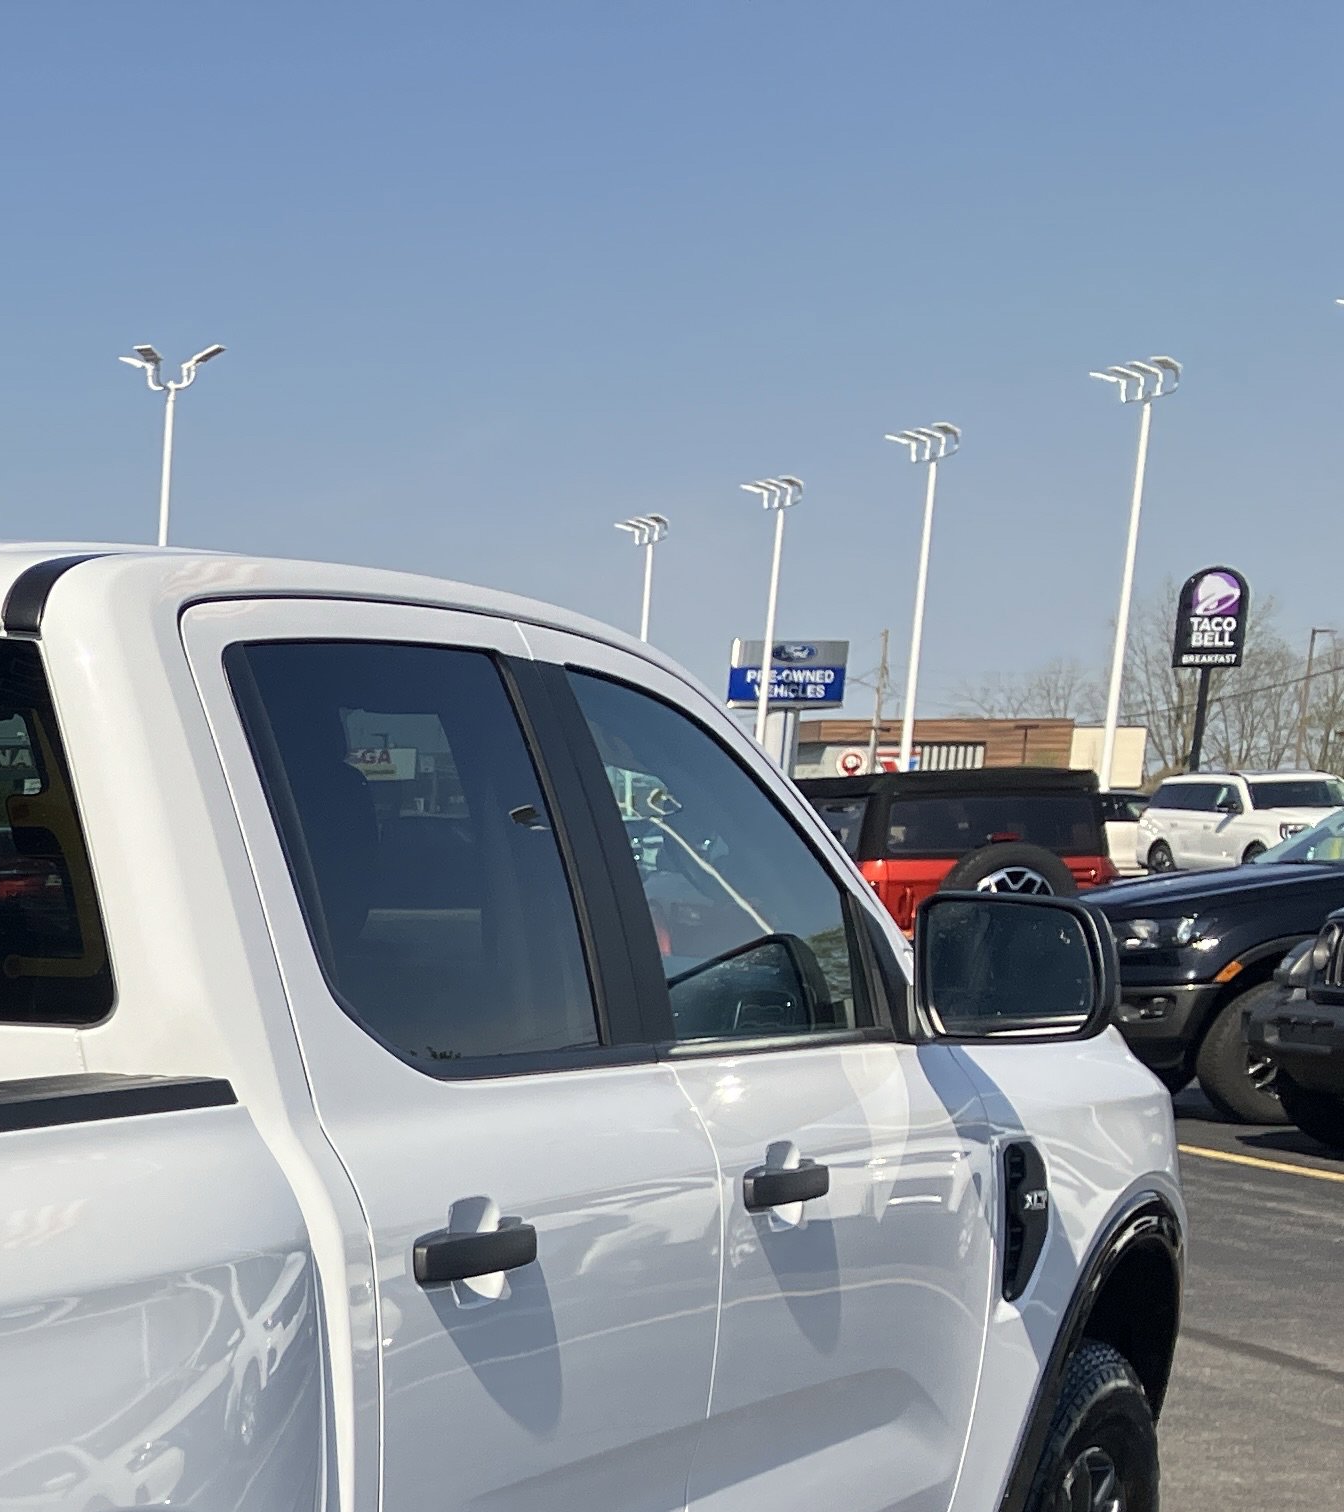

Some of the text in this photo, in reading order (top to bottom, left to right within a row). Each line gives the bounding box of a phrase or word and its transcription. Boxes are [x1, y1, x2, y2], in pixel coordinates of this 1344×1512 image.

[1189, 616, 1238, 632] TACO
[1191, 631, 1235, 649] BELL
[1181, 653, 1238, 665] BREAKFAST
